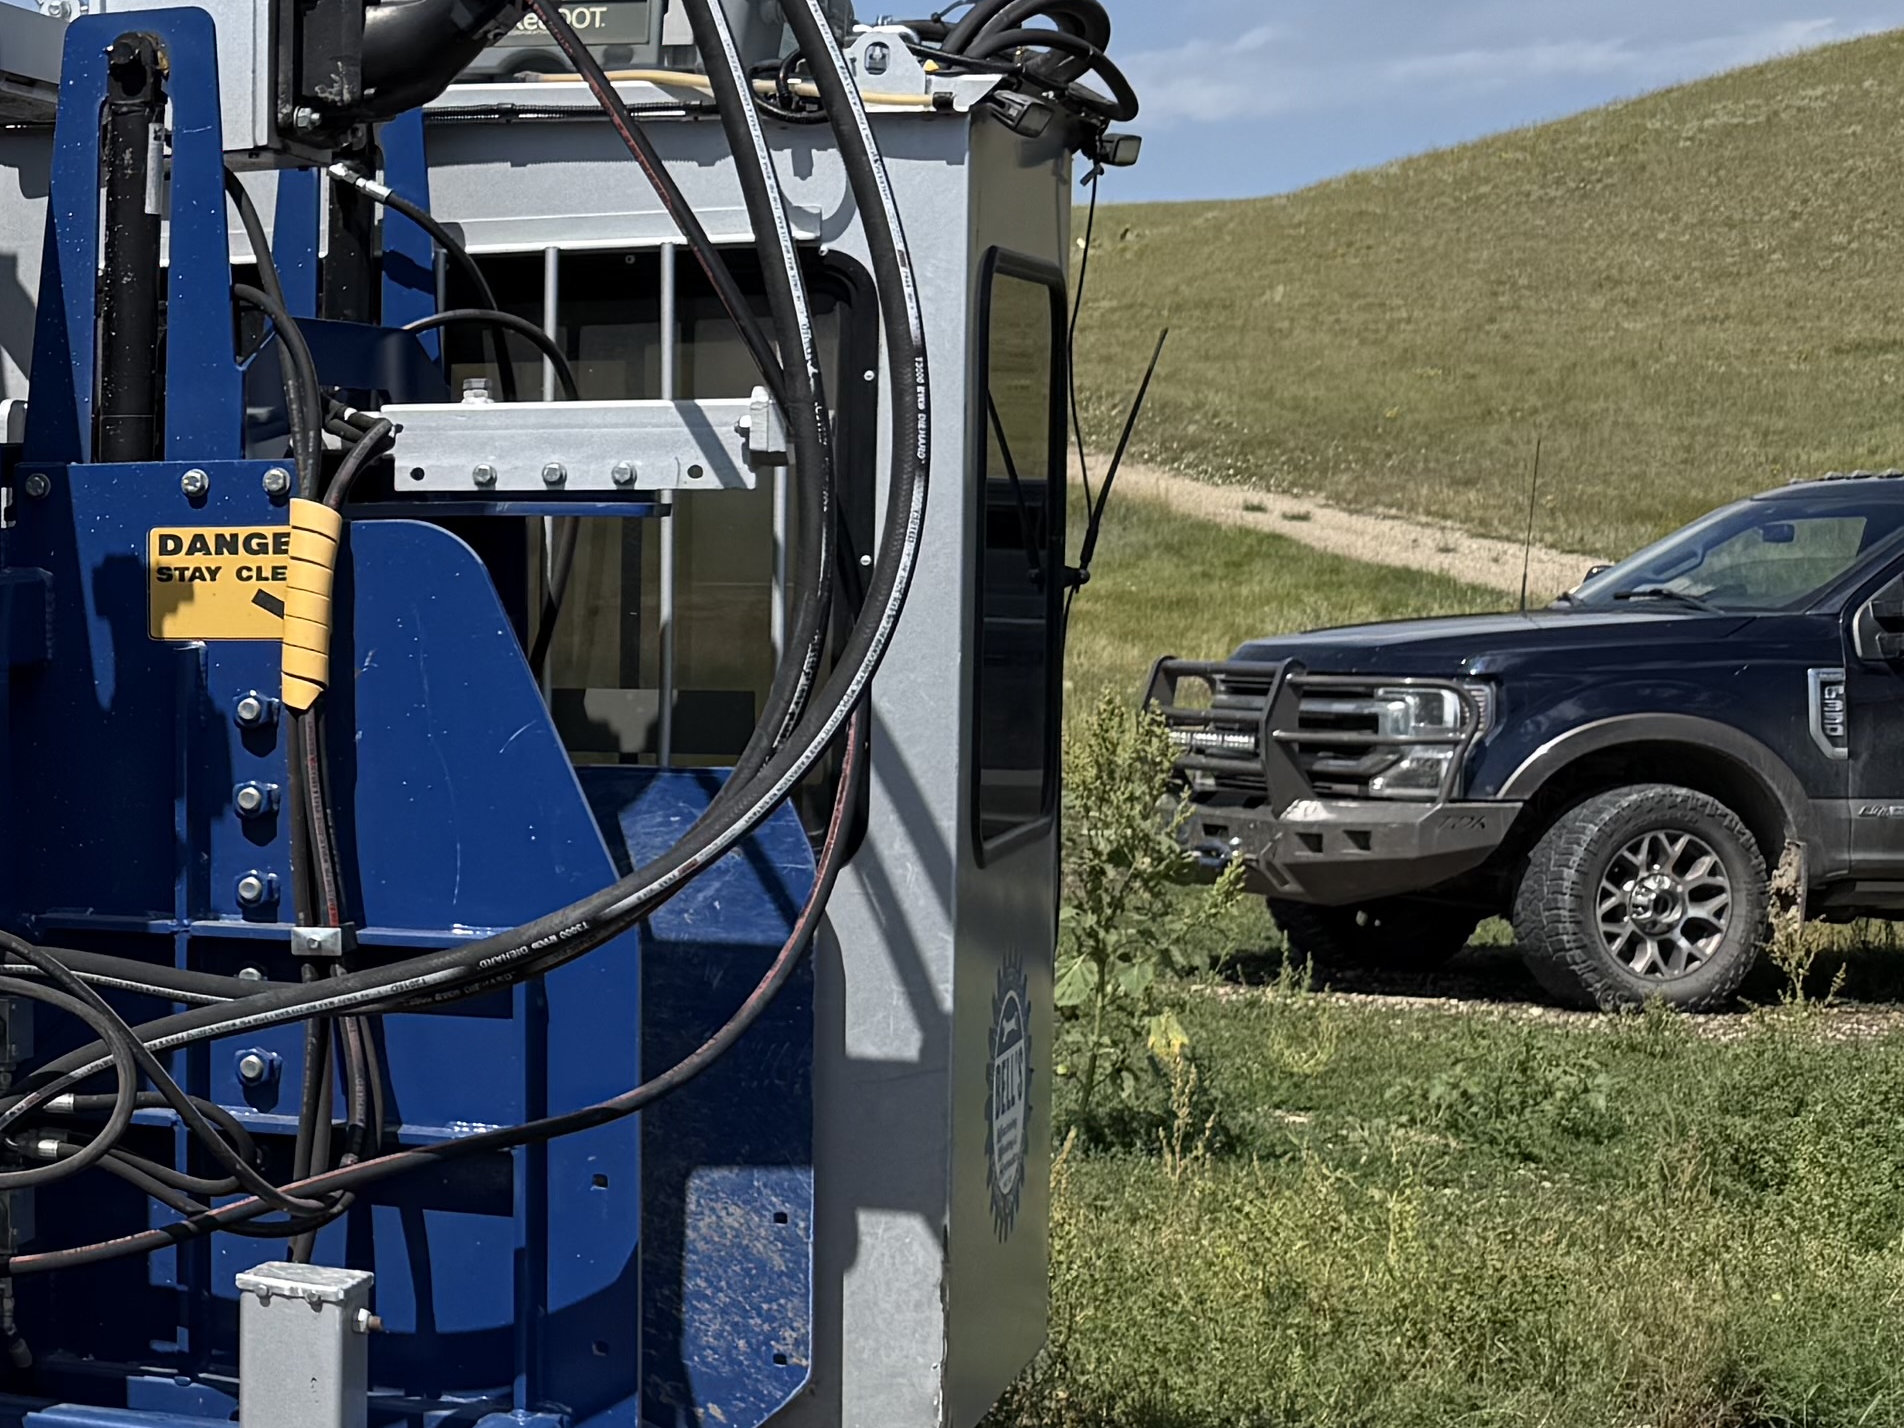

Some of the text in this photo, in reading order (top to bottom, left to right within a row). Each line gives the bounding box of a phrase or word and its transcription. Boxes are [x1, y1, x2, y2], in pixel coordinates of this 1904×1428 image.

[157, 533, 291, 557] DANGE
[156, 565, 288, 583] STAY CLE
[995, 1046, 1023, 1120] BELL'S
